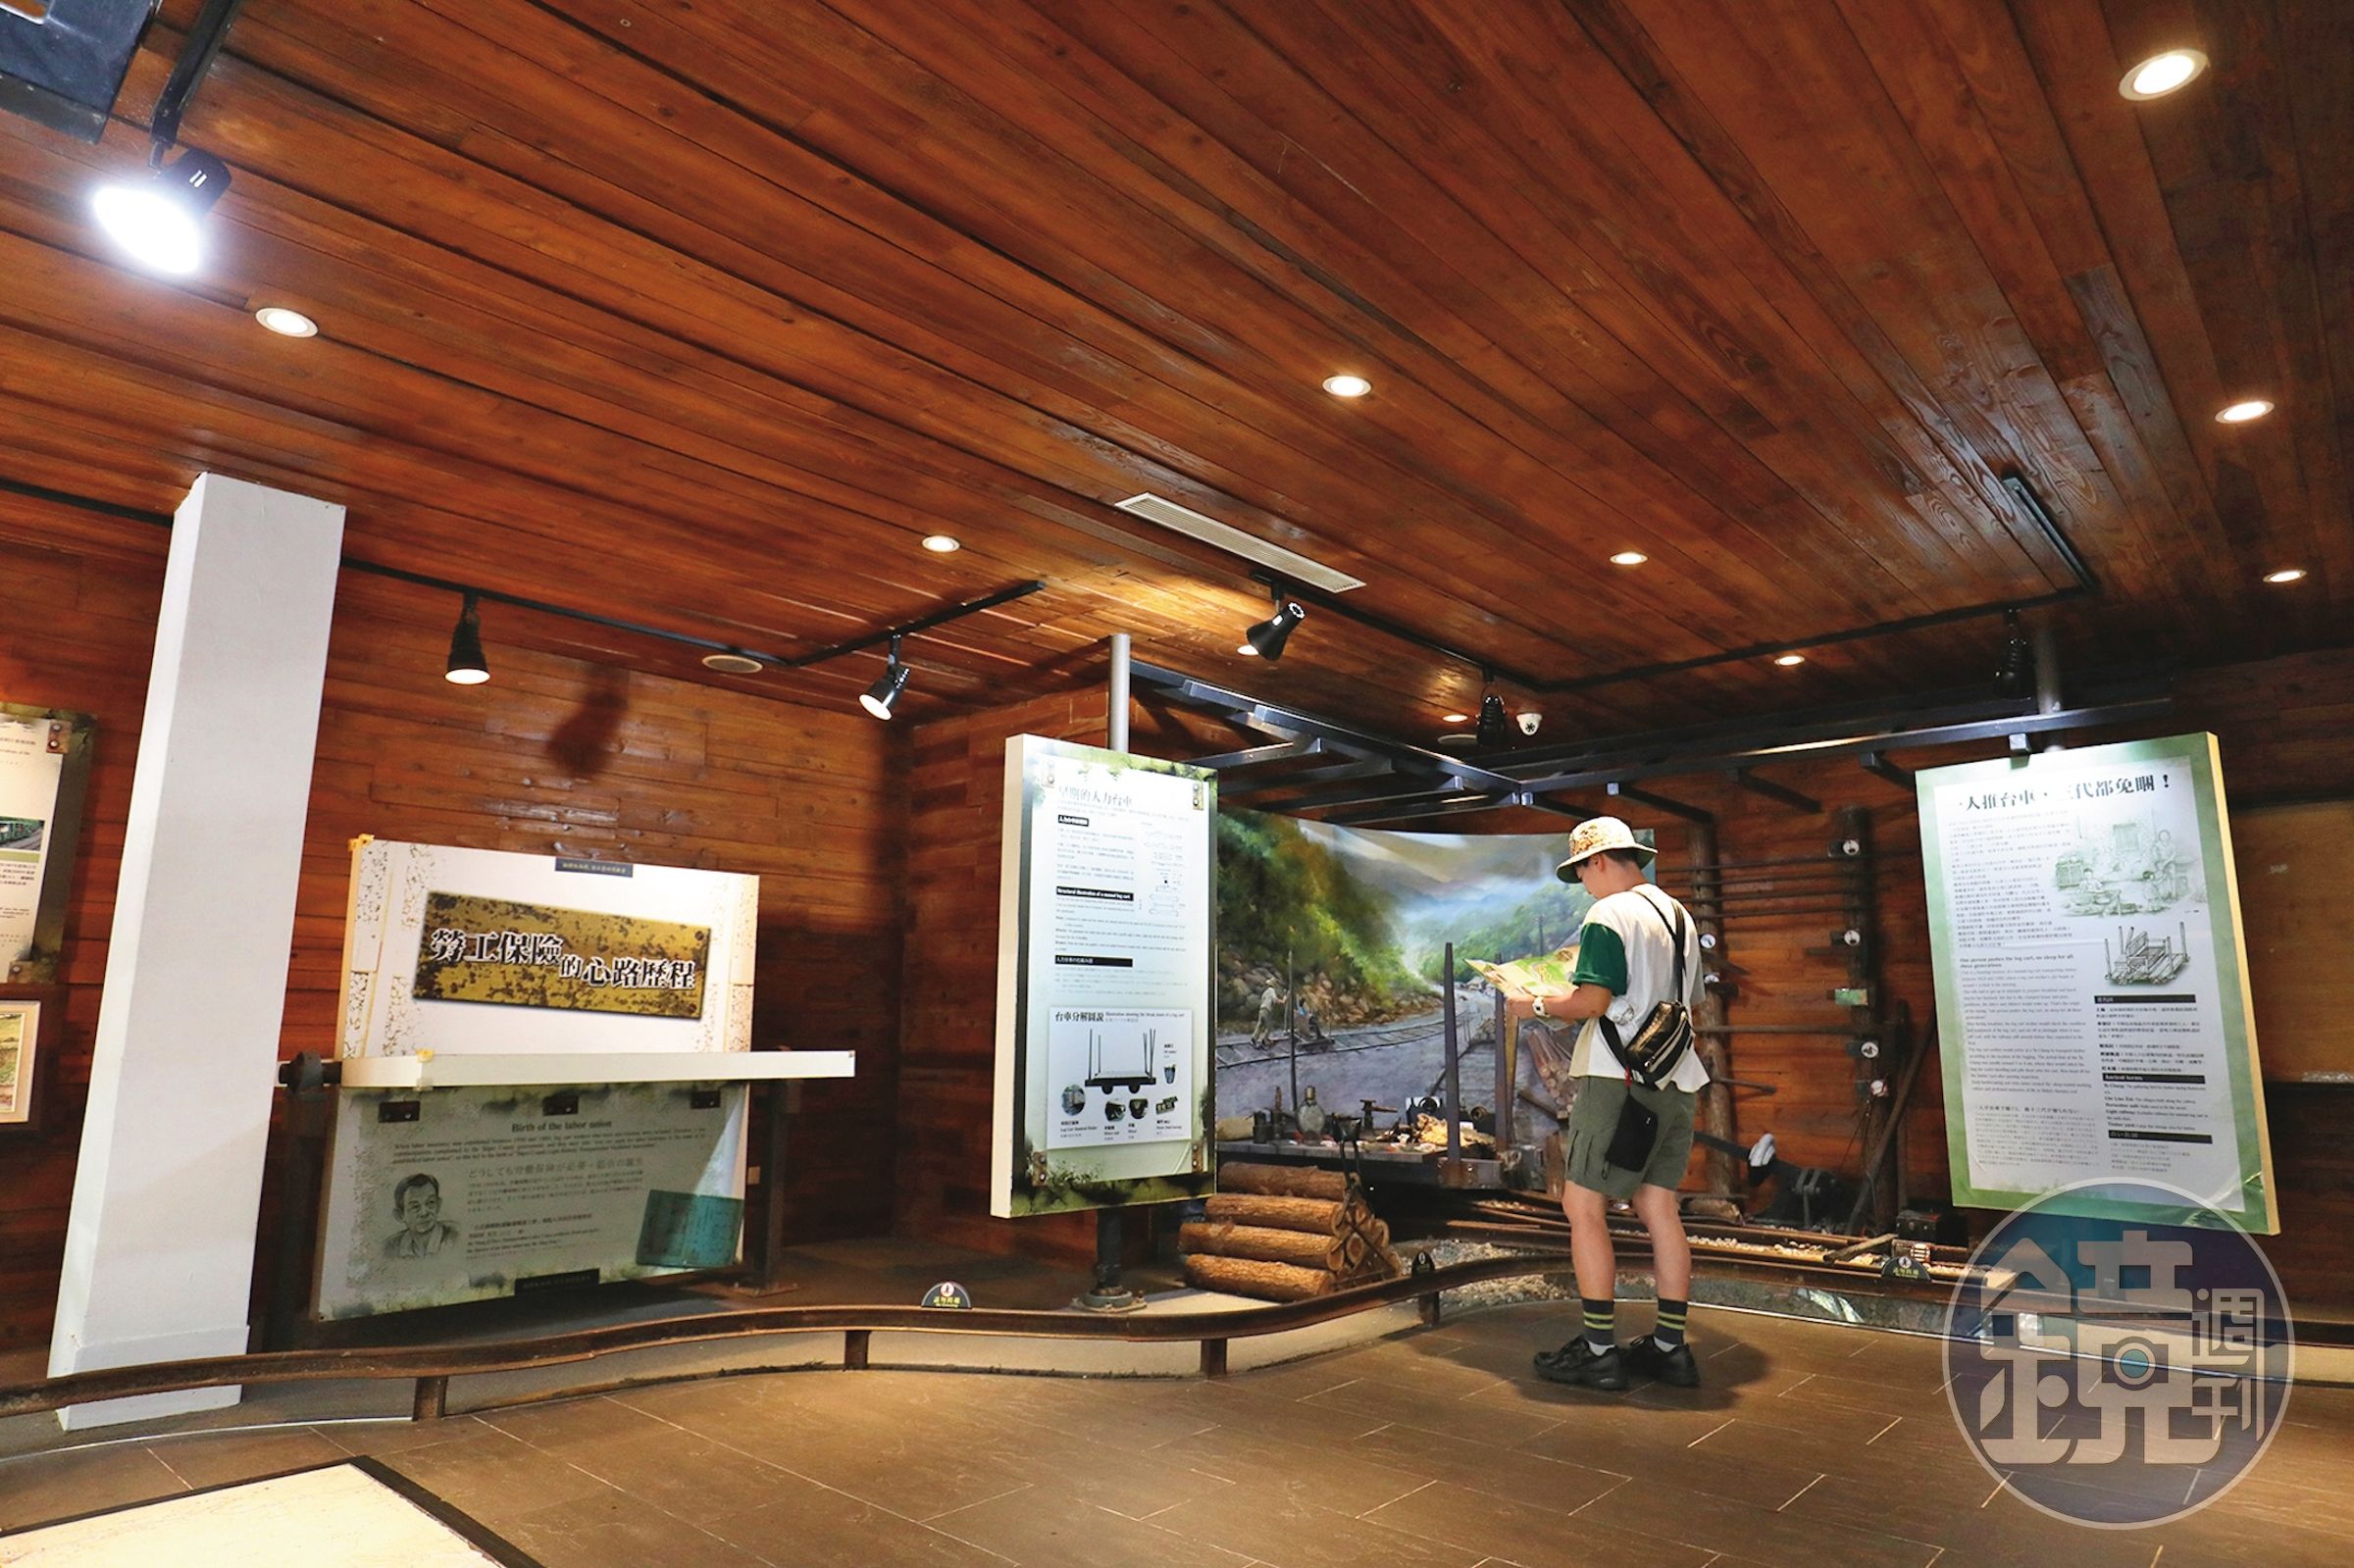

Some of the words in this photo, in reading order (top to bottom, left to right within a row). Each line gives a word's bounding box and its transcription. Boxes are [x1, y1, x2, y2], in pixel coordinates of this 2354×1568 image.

[430, 928, 696, 989] 勞工保險的心路歷程
[512, 1122, 536, 1133] Birth
[537, 1122, 546, 1131] of
[548, 1121, 563, 1131] the
